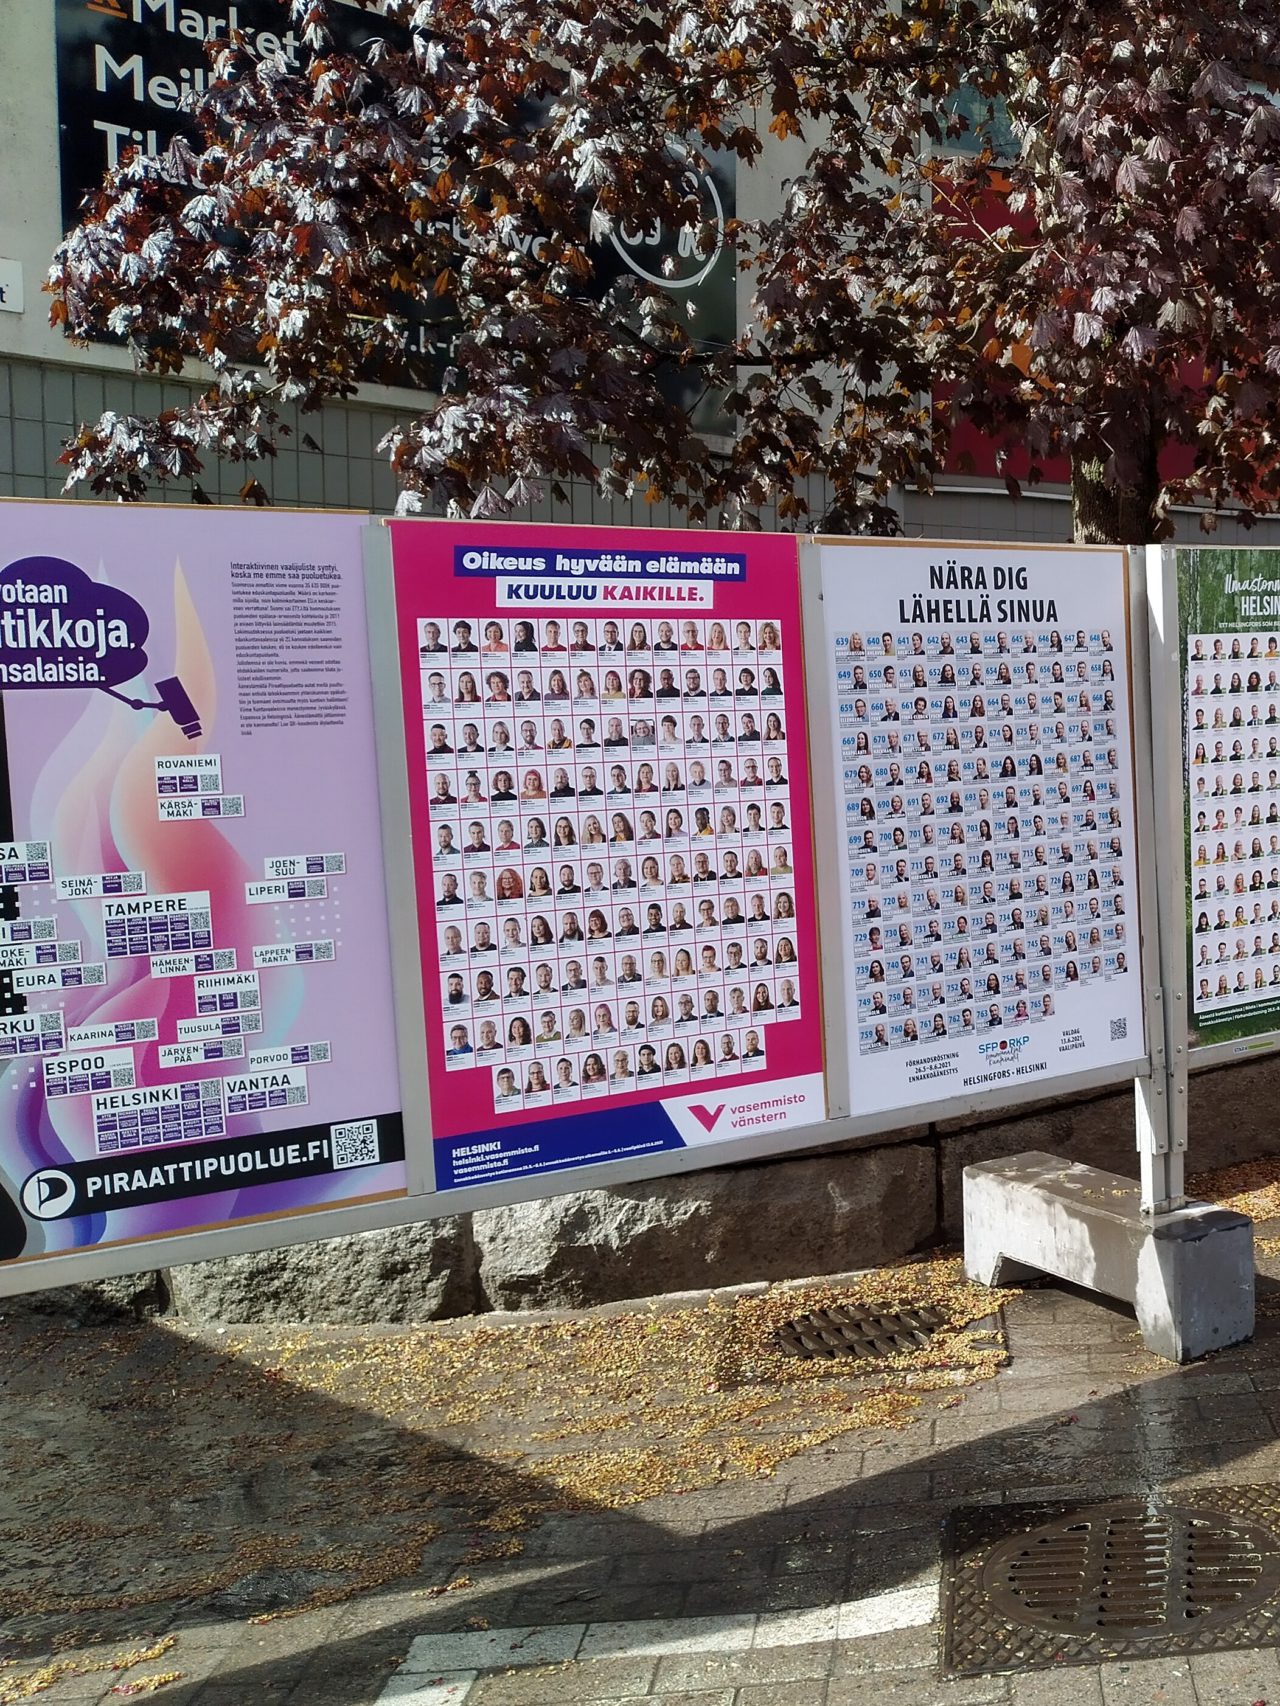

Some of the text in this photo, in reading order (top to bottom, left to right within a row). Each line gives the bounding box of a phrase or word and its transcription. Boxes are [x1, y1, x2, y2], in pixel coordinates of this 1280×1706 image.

[462, 551, 740, 575] Oikeus hyvään elämään
[230, 571, 252, 579] koska
[930, 560, 1028, 590] NÄRA DIG
[0, 579, 68, 603] otaan
[507, 583, 705, 602] KUULUU KAIKILLE.
[899, 593, 1058, 624] LÄHELLÄ SINUA
[0, 608, 136, 659] tikkoja,
[836, 637, 908, 647] 639 640 641
[838, 669, 910, 680] 649 650 651
[840, 701, 912, 713] 659 660 661
[842, 735, 886, 746] 669 670
[157, 758, 217, 769] ROVANIEMI
[844, 768, 888, 779] 679 680
[160, 799, 198, 810] KÄRSÄ-
[847, 800, 890, 812] 689 690
[849, 832, 892, 844] 699 700
[269, 859, 301, 869] JOEN-
[851, 864, 894, 877] 709 710
[275, 868, 296, 877] SUU
[61, 878, 98, 889] SEINÄ-
[68, 887, 93, 897] JOKI
[248, 885, 285, 896] LIPERI
[105, 898, 188, 917] TAMPERE
[853, 897, 896, 909] 719 720
[855, 929, 898, 942] 729 730
[254, 947, 295, 958] LAPPEEN-
[152, 955, 194, 968] HÄMEEN-
[262, 955, 289, 964] RANTA
[160, 965, 188, 974] LINNA
[857, 961, 899, 974] 739 740
[16, 974, 57, 988] EURA
[197, 974, 256, 989] RIIHIMÄKI
[859, 993, 901, 1007] 749 750
[69, 1029, 114, 1042] KAARINA
[178, 1023, 221, 1035] TUUSULA
[861, 1025, 903, 1039] 759 760
[161, 1045, 203, 1057] JÄRVEN-
[978, 1036, 1030, 1053] SFP RKP
[45, 1056, 105, 1075] ESPOO
[250, 1053, 289, 1065] PORVOO
[963, 1062, 1048, 1087] HELSINGFORS HELSINKI
[227, 1074, 291, 1093] VANTAA
[96, 1087, 179, 1110] HELSINKI
[730, 1094, 806, 1115] vasemmisto
[731, 1111, 787, 1128] vänstern
[452, 1142, 501, 1158] HELSINKI
[452, 1144, 540, 1167] helsinki.vasemmisto.fi
[86, 1139, 330, 1198] PIRAATTIPUOLUE.FI
[453, 1159, 509, 1175] vasemmisto.fi
